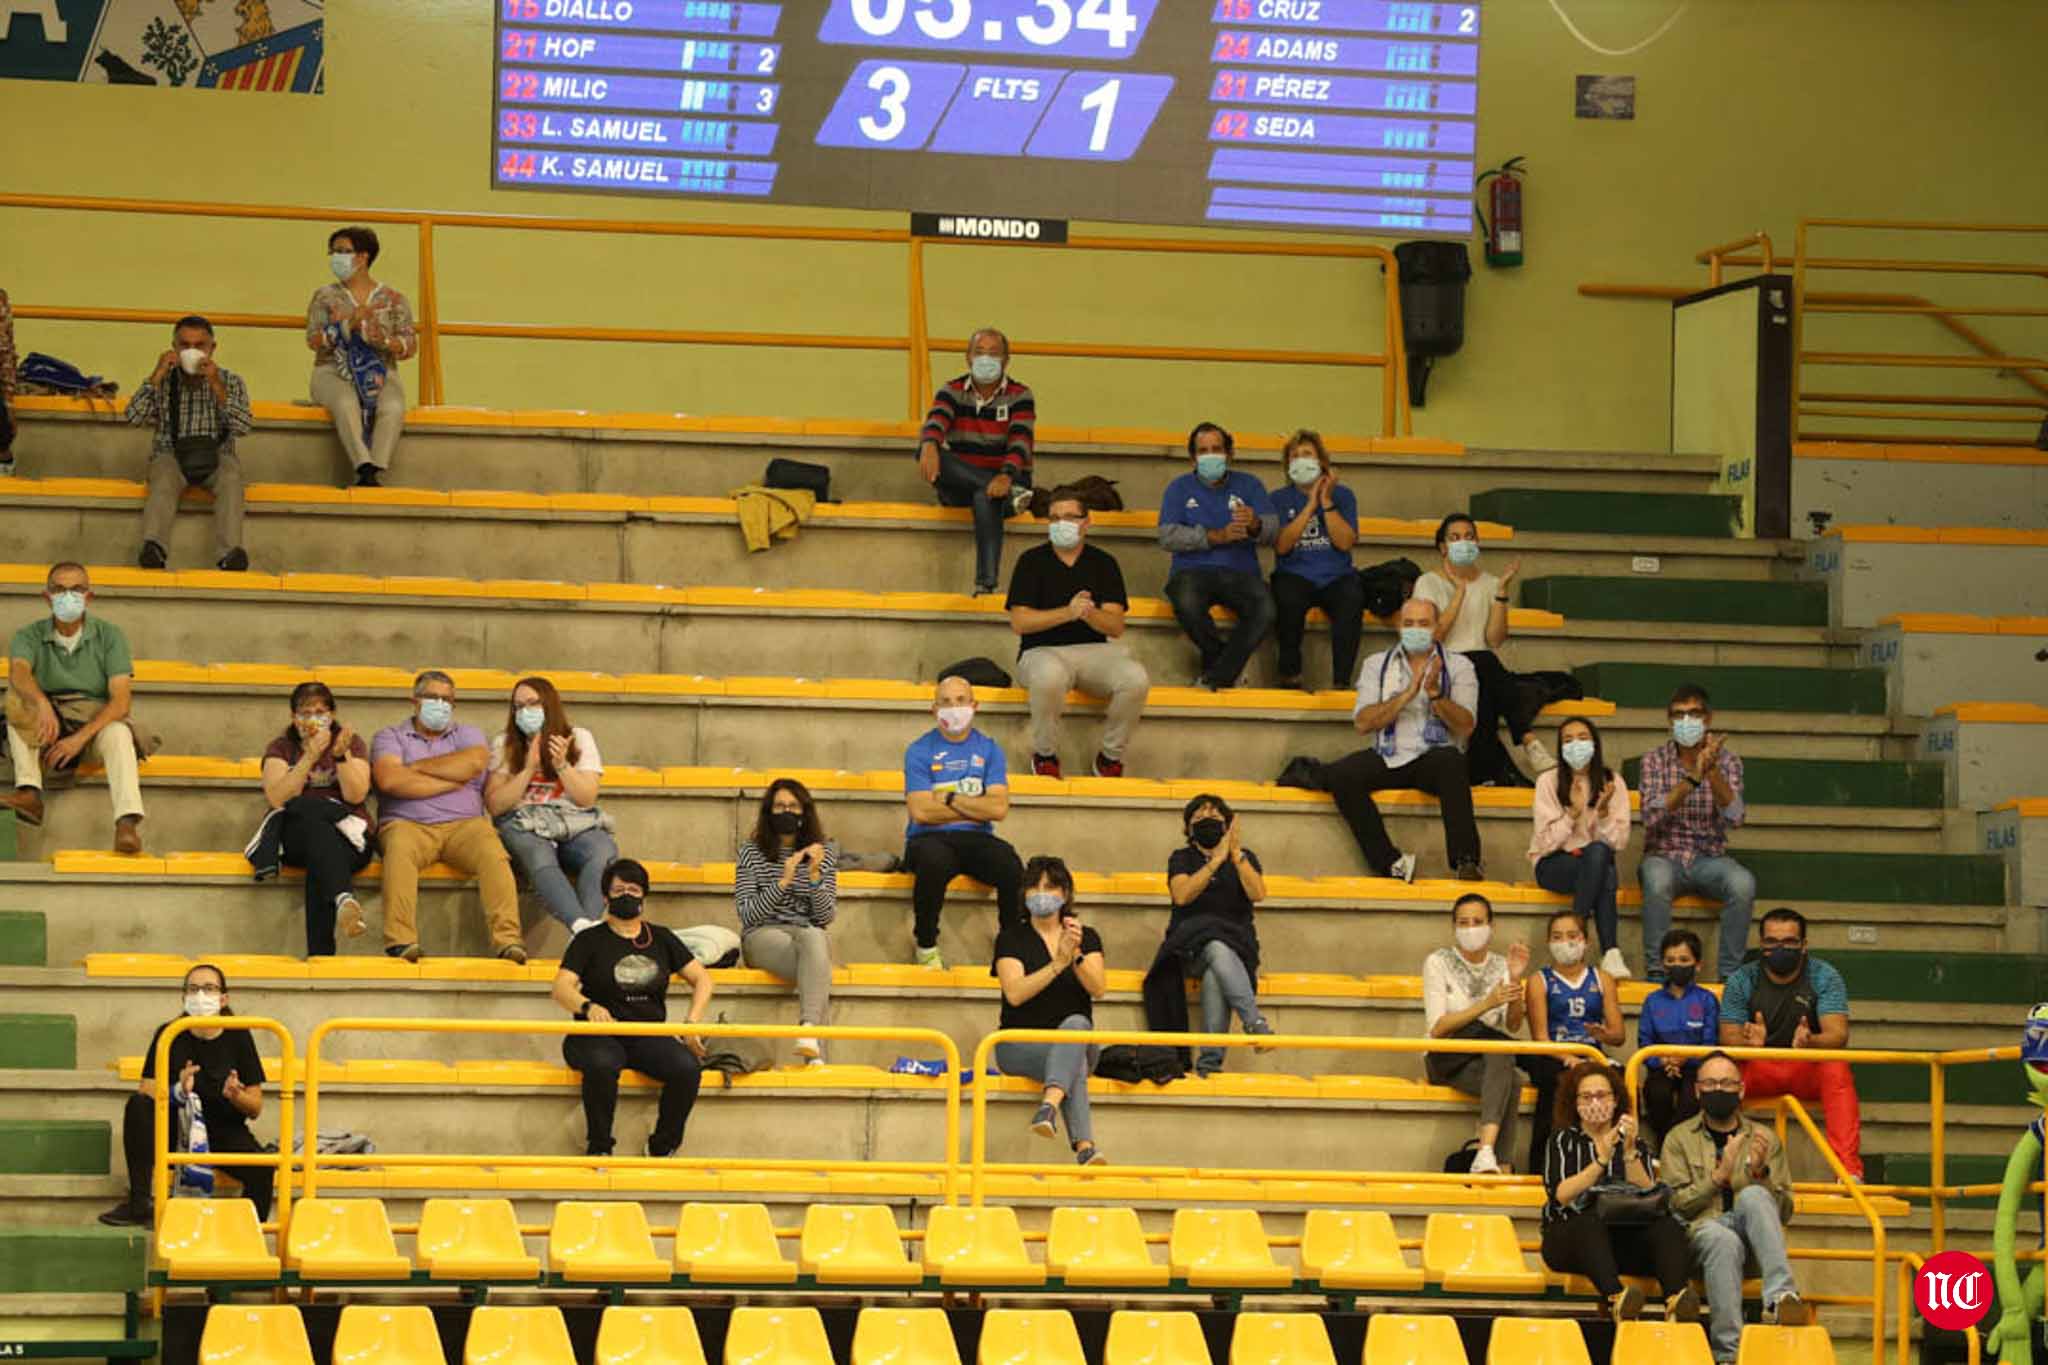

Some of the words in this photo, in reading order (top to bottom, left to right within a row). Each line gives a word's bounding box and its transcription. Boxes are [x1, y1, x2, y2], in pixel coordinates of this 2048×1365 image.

[544, 0, 633, 21] DIALLO
[1258, 0, 1321, 21] CRUZ
[1457, 8, 1476, 33] 2
[504, 32, 538, 58] 21
[543, 37, 597, 59] HOF
[757, 48, 775, 72] 2
[1216, 33, 1251, 60] 24
[1255, 37, 1339, 62] ADAMS
[503, 72, 539, 99] 22
[542, 76, 608, 100] MILIC
[755, 87, 774, 112] 3
[1216, 71, 1248, 98] 31
[1255, 73, 1332, 101] PÉREZ
[858, 66, 911, 142] 3
[973, 76, 1040, 102] FLTS
[1080, 79, 1121, 152] 1
[503, 112, 537, 138] 33
[541, 116, 562, 137] L.
[569, 117, 668, 143] SAMUEL
[1215, 113, 1249, 138] 42
[1254, 116, 1315, 139] SEDA
[502, 153, 536, 178] 44
[540, 156, 564, 177] K.
[571, 157, 669, 183] SAMUEL
[954, 217, 1040, 239] MONDO
